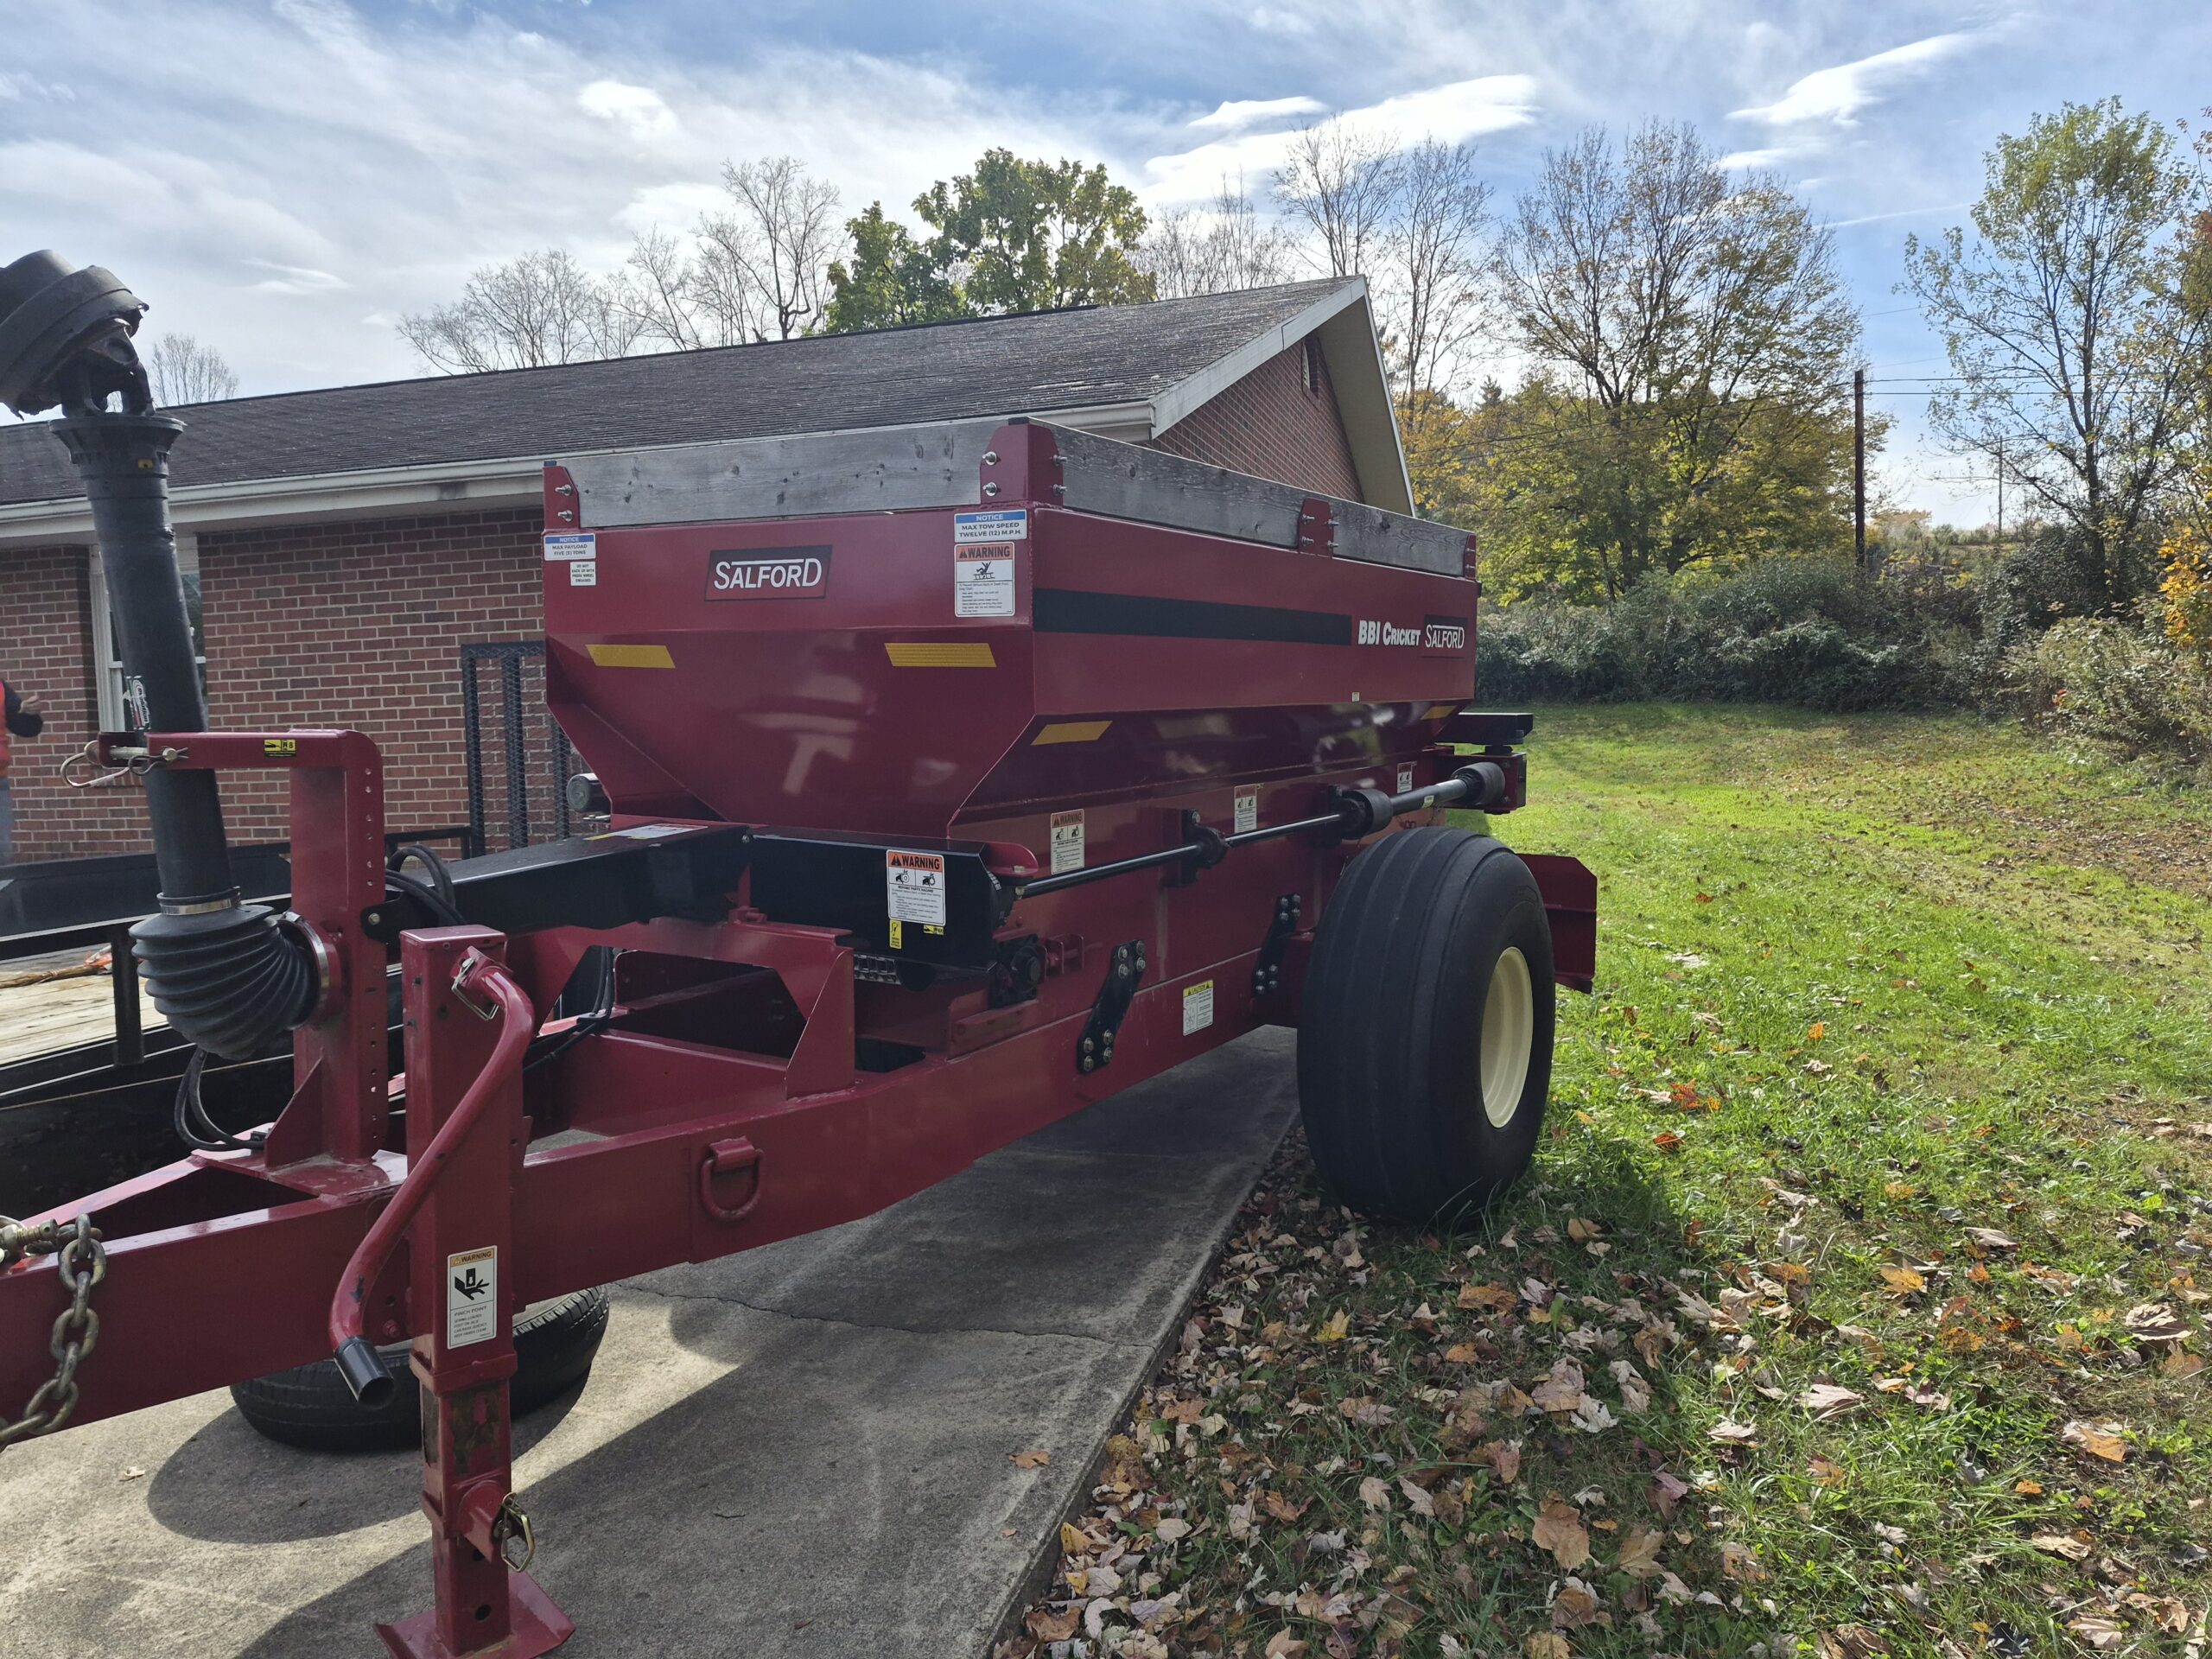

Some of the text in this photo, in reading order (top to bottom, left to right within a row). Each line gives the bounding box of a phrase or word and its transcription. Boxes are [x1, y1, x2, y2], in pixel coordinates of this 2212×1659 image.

[968, 546, 1010, 558] WARNING
[714, 558, 823, 589] SALFORD
[1358, 620, 1381, 645] BBI
[1426, 624, 1465, 649] SALFORD
[902, 855, 940, 869] WARNING
[461, 1251, 492, 1262] WARNING
